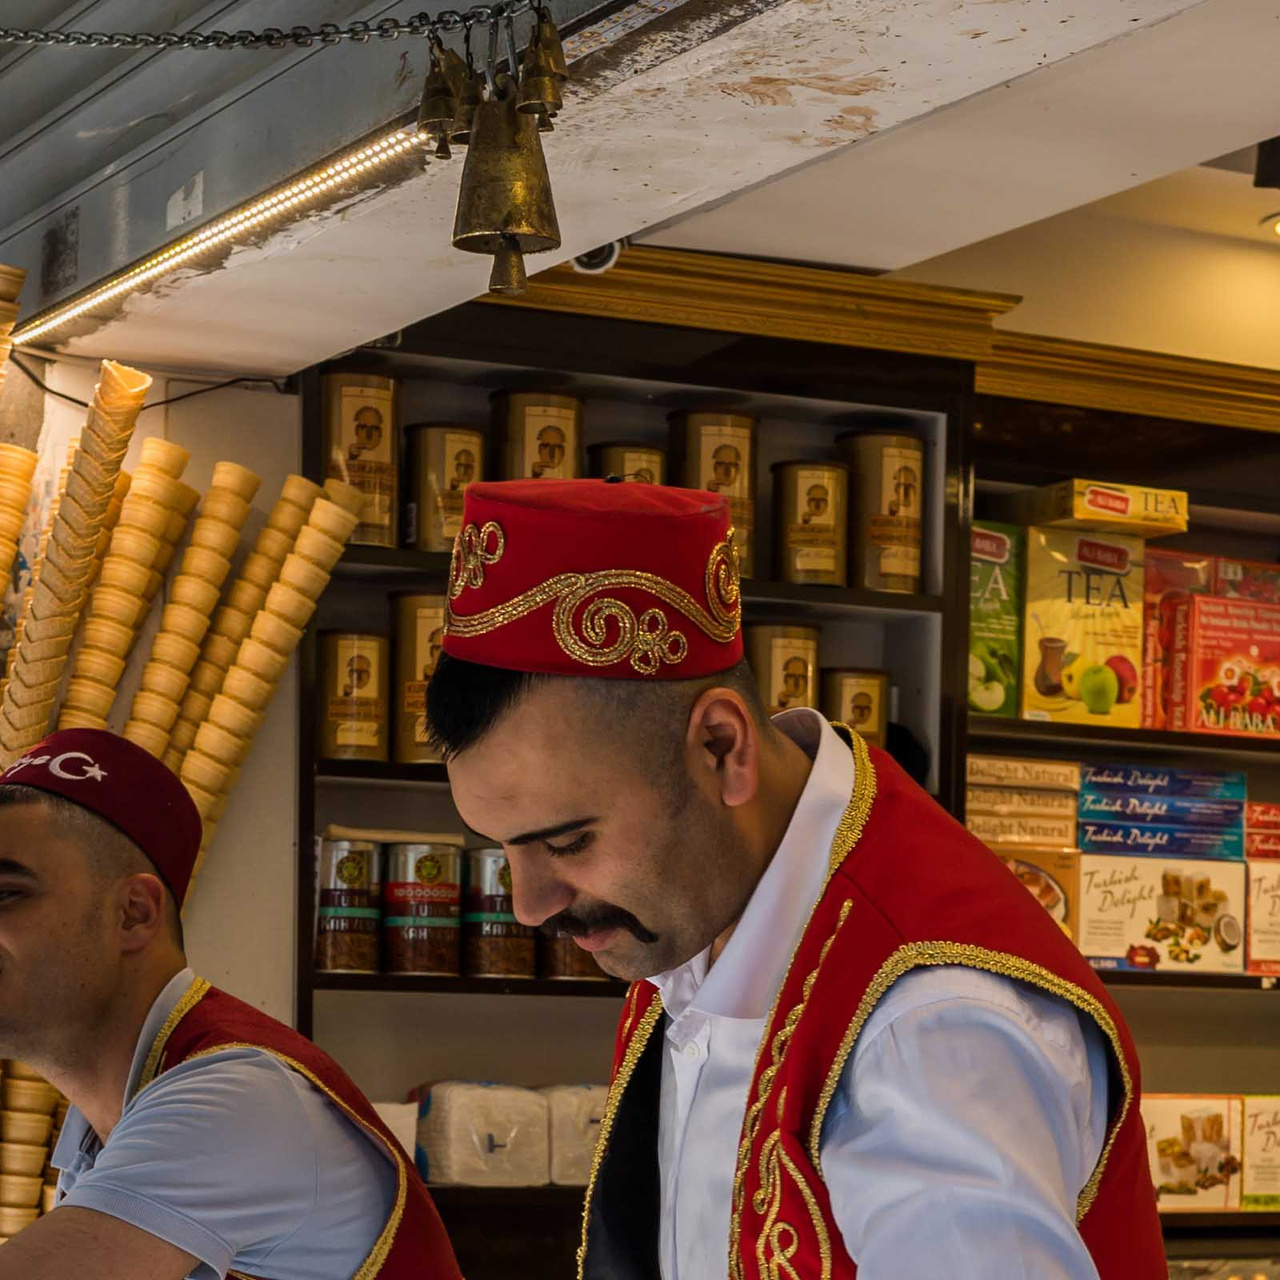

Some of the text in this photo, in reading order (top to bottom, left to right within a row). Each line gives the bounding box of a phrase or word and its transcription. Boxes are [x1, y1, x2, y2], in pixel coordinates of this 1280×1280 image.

[1140, 491, 1180, 515] TEA
[1059, 569, 1129, 609] TEA
[1197, 707, 1274, 732] ALI BABA
[1023, 766, 1073, 784] Natural
[1083, 767, 1124, 785] Turkish
[1128, 769, 1170, 793] Delight
[1082, 795, 1123, 812] Turkish
[1126, 797, 1168, 821] Delight
[1017, 821, 1068, 838] Natural
[1084, 825, 1124, 843] Turkish
[1126, 827, 1169, 851] Delight
[1083, 865, 1138, 895] Turkish
[1097, 885, 1154, 919] Delight
